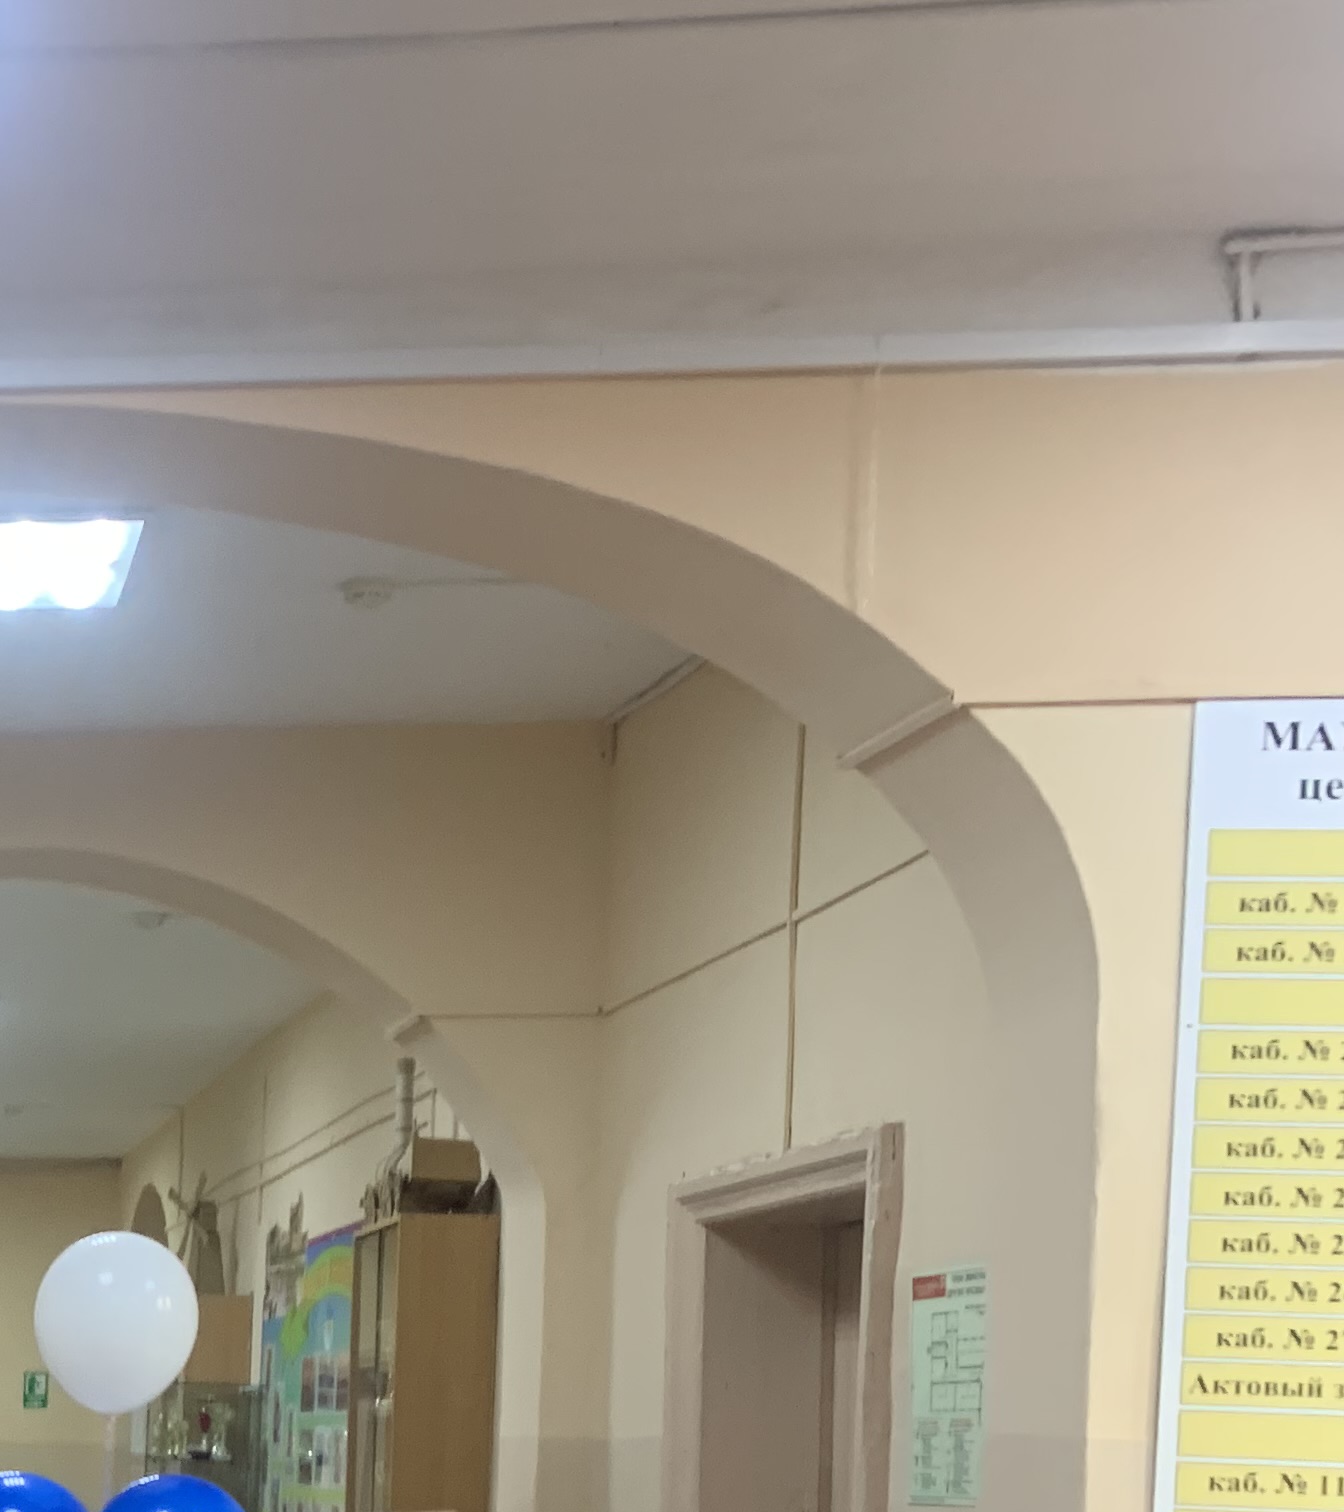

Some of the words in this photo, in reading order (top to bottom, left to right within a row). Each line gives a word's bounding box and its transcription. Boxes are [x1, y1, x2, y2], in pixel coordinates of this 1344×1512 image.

[1262, 720, 1344, 751] МА
[1239, 892, 1295, 913] каб.
[1236, 941, 1294, 962] каб.
[1231, 1039, 1288, 1060] каб.
[1228, 1088, 1286, 1109] каб.
[1226, 1137, 1284, 1158] каб.
[1224, 1186, 1280, 1207] каб.
[1222, 1232, 1278, 1253] каб.
[1219, 1280, 1276, 1301] каб.
[1328, 1282, 1344, 1302] 2
[1216, 1327, 1273, 1348] каб.
[1326, 1330, 1344, 1350] 2
[1189, 1373, 1322, 1399] Актовый
[1209, 1472, 1266, 1493] каб.
